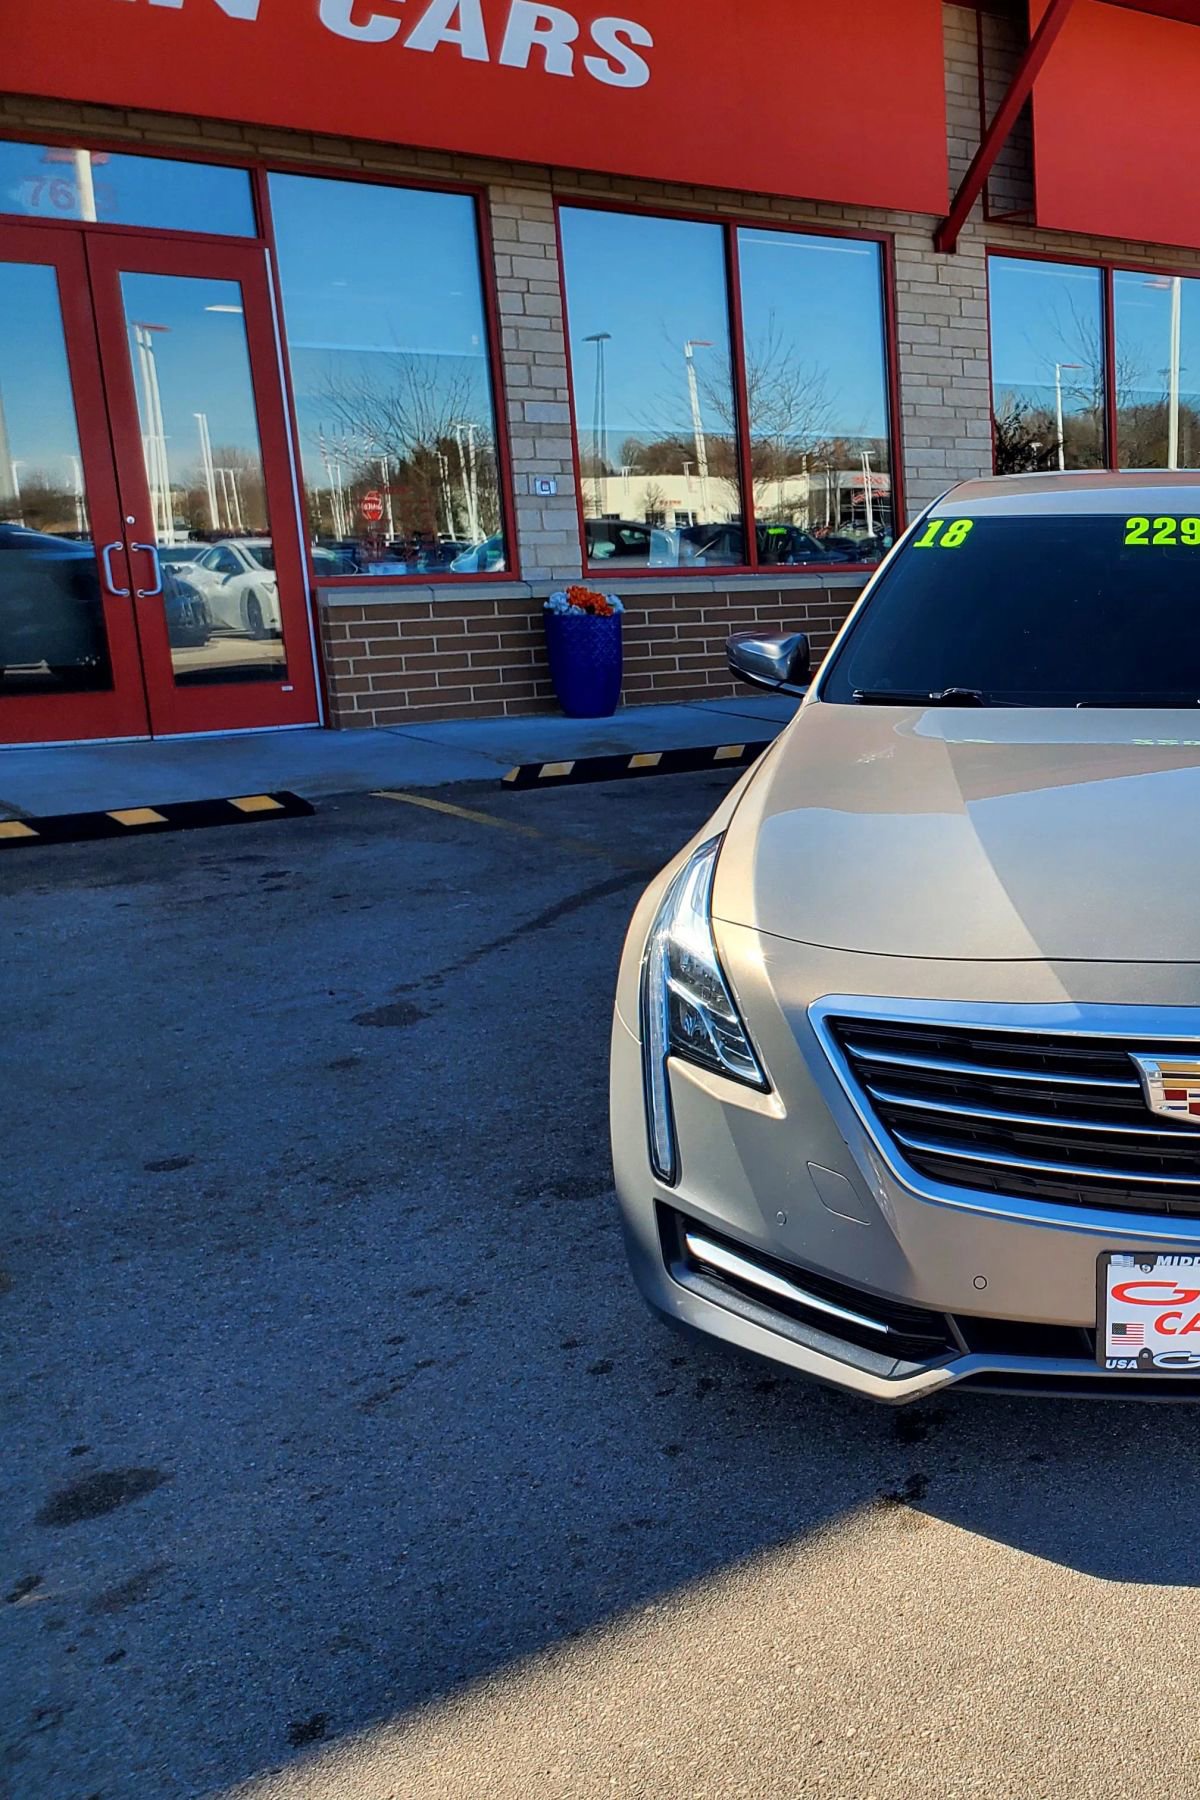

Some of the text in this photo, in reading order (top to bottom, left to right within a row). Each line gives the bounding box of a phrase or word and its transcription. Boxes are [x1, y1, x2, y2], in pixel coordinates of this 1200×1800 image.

[317, 0, 654, 88] CARS
[912, 518, 975, 549] 18
[1105, 1358, 1139, 1370] USA
